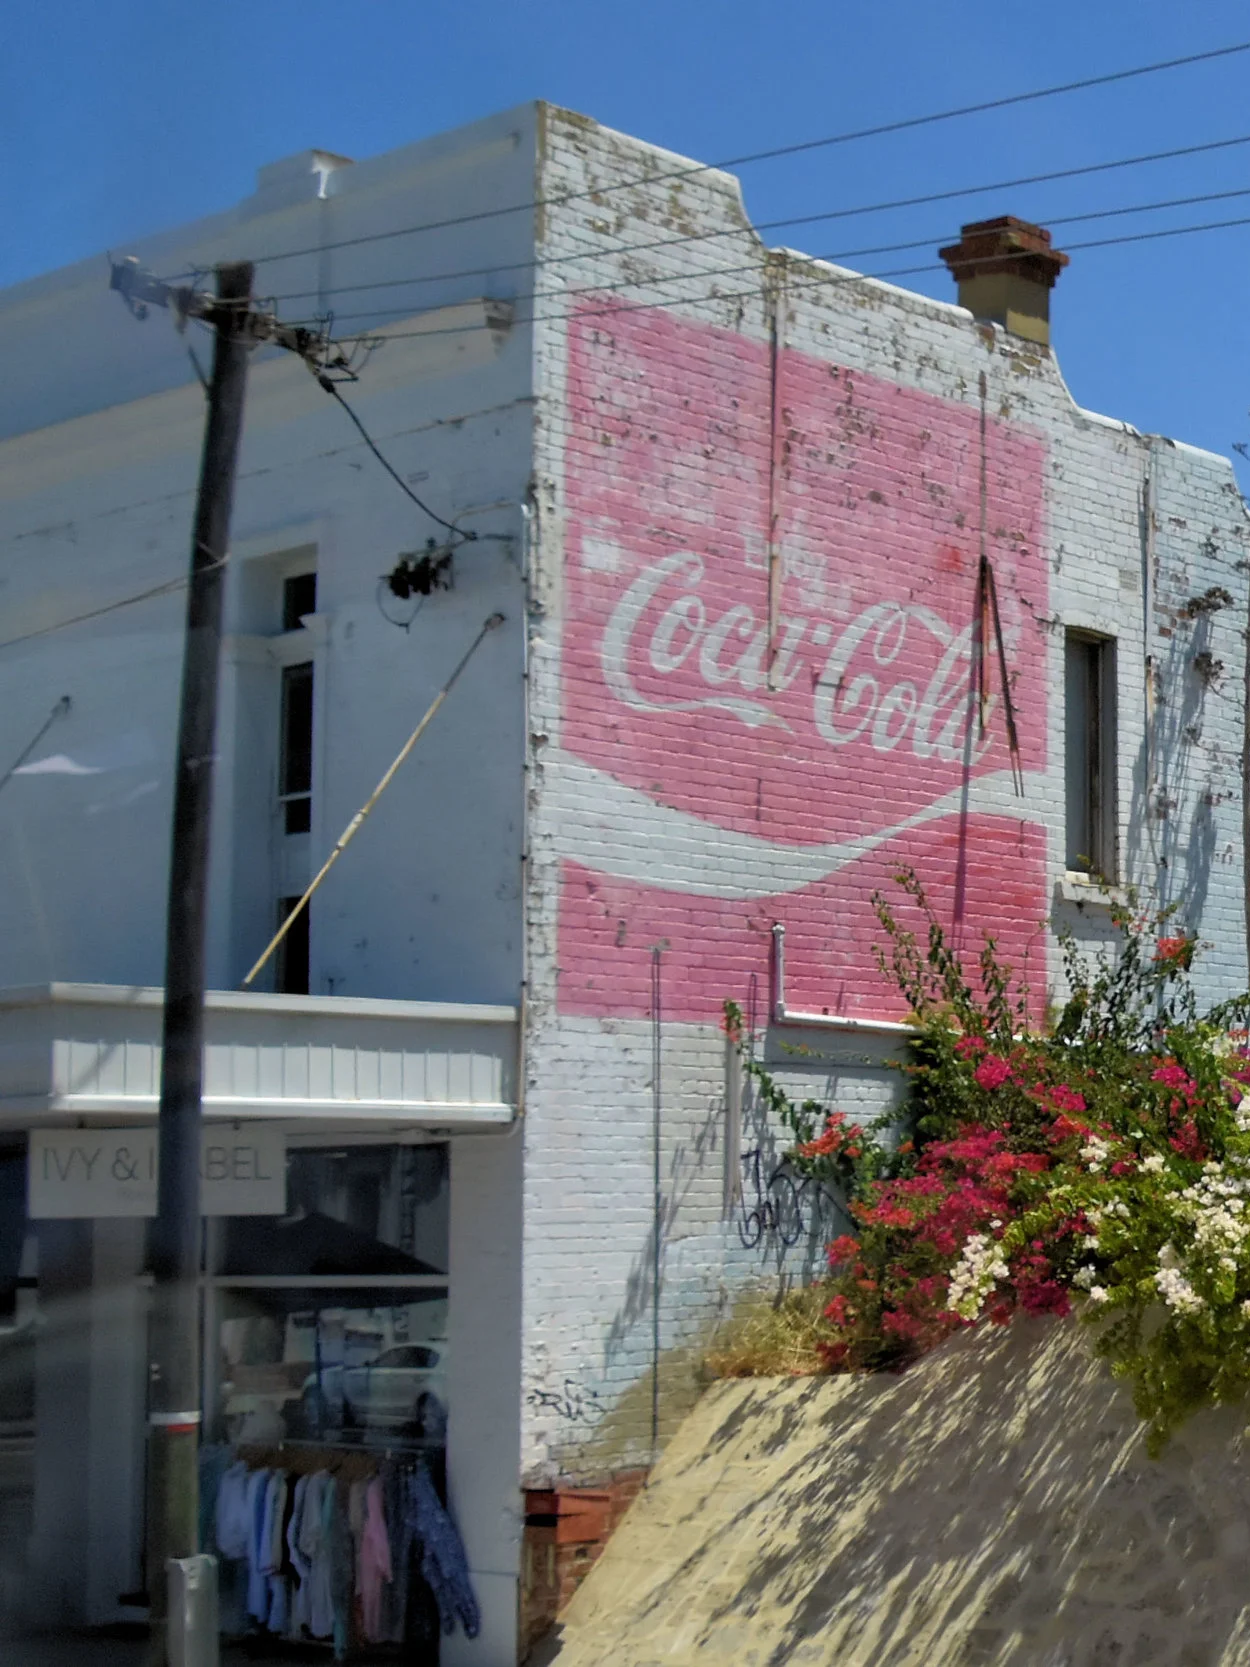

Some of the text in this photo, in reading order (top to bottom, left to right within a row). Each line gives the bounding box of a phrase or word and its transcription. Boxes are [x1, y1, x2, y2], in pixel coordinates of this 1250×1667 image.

[43, 1146, 272, 1181] IVY & IBEL
